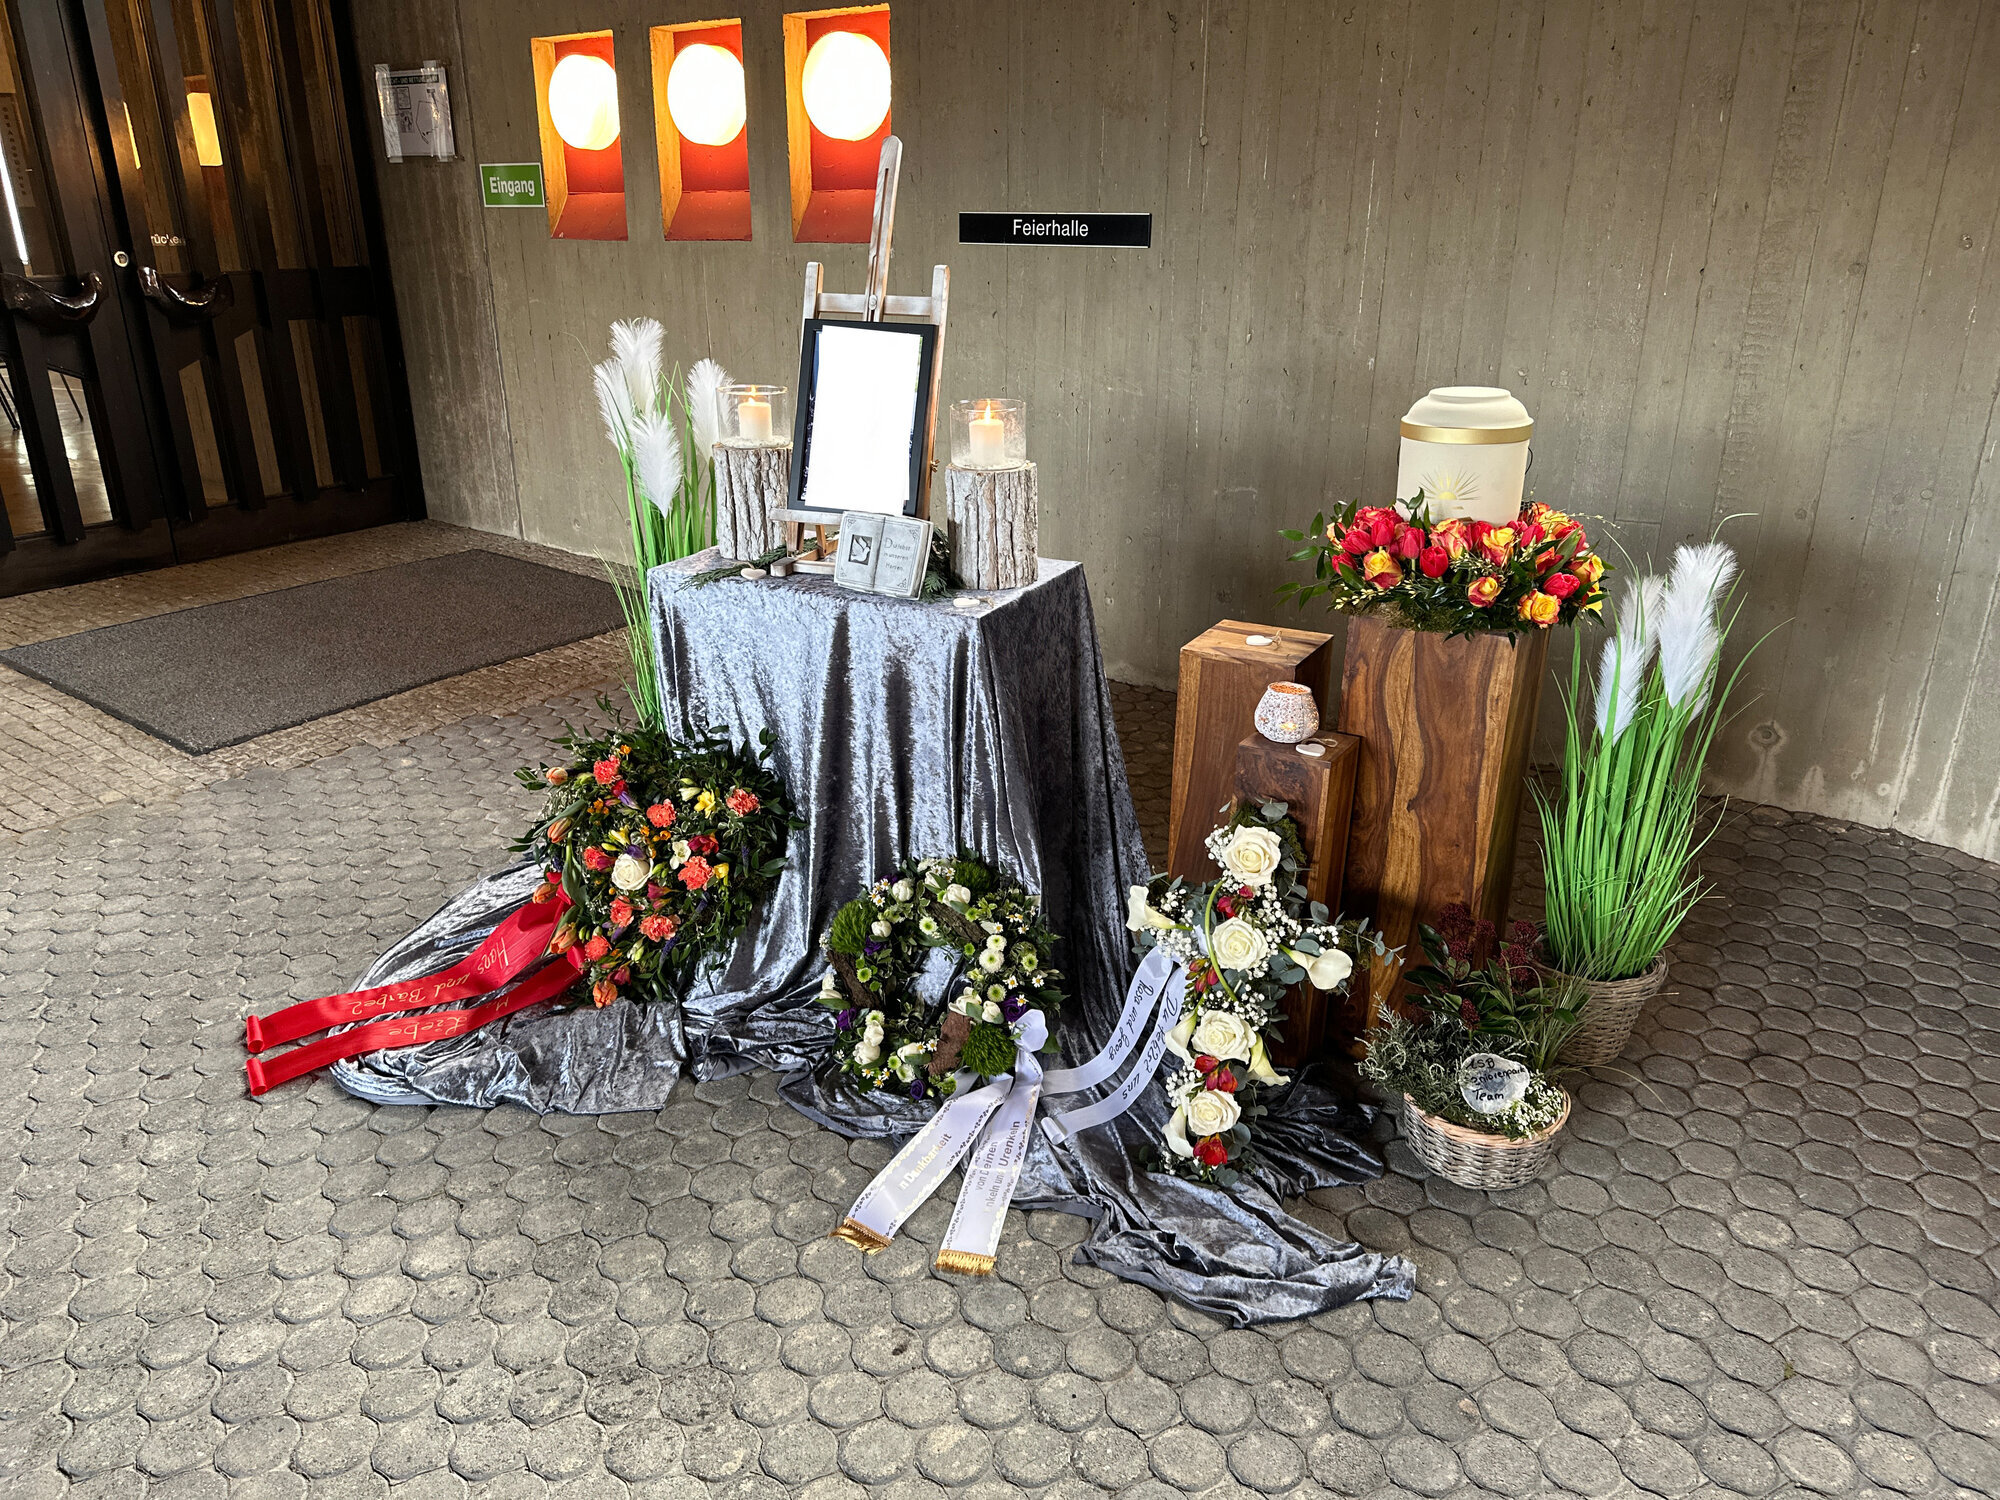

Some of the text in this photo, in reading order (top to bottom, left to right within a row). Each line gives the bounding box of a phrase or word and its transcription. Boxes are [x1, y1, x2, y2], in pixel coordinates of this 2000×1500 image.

[489, 176, 535, 197] Eingang
[1012, 218, 1089, 237] Feierhalle
[477, 937, 509, 975] Hans
[434, 971, 471, 998] und
[1134, 979, 1155, 1006] Rosa
[1162, 991, 1179, 1021] Du
[388, 1015, 468, 1041] Liebe
[1126, 1006, 1139, 1035] und
[1122, 1072, 1140, 1100] uns
[1472, 1087, 1504, 1101] Team
[903, 1133, 953, 1183] Dankbarkeit
[984, 1182, 1000, 1213] nkeln
[1000, 1120, 1021, 1168] Urenkeln
[976, 1173, 989, 1191] von
